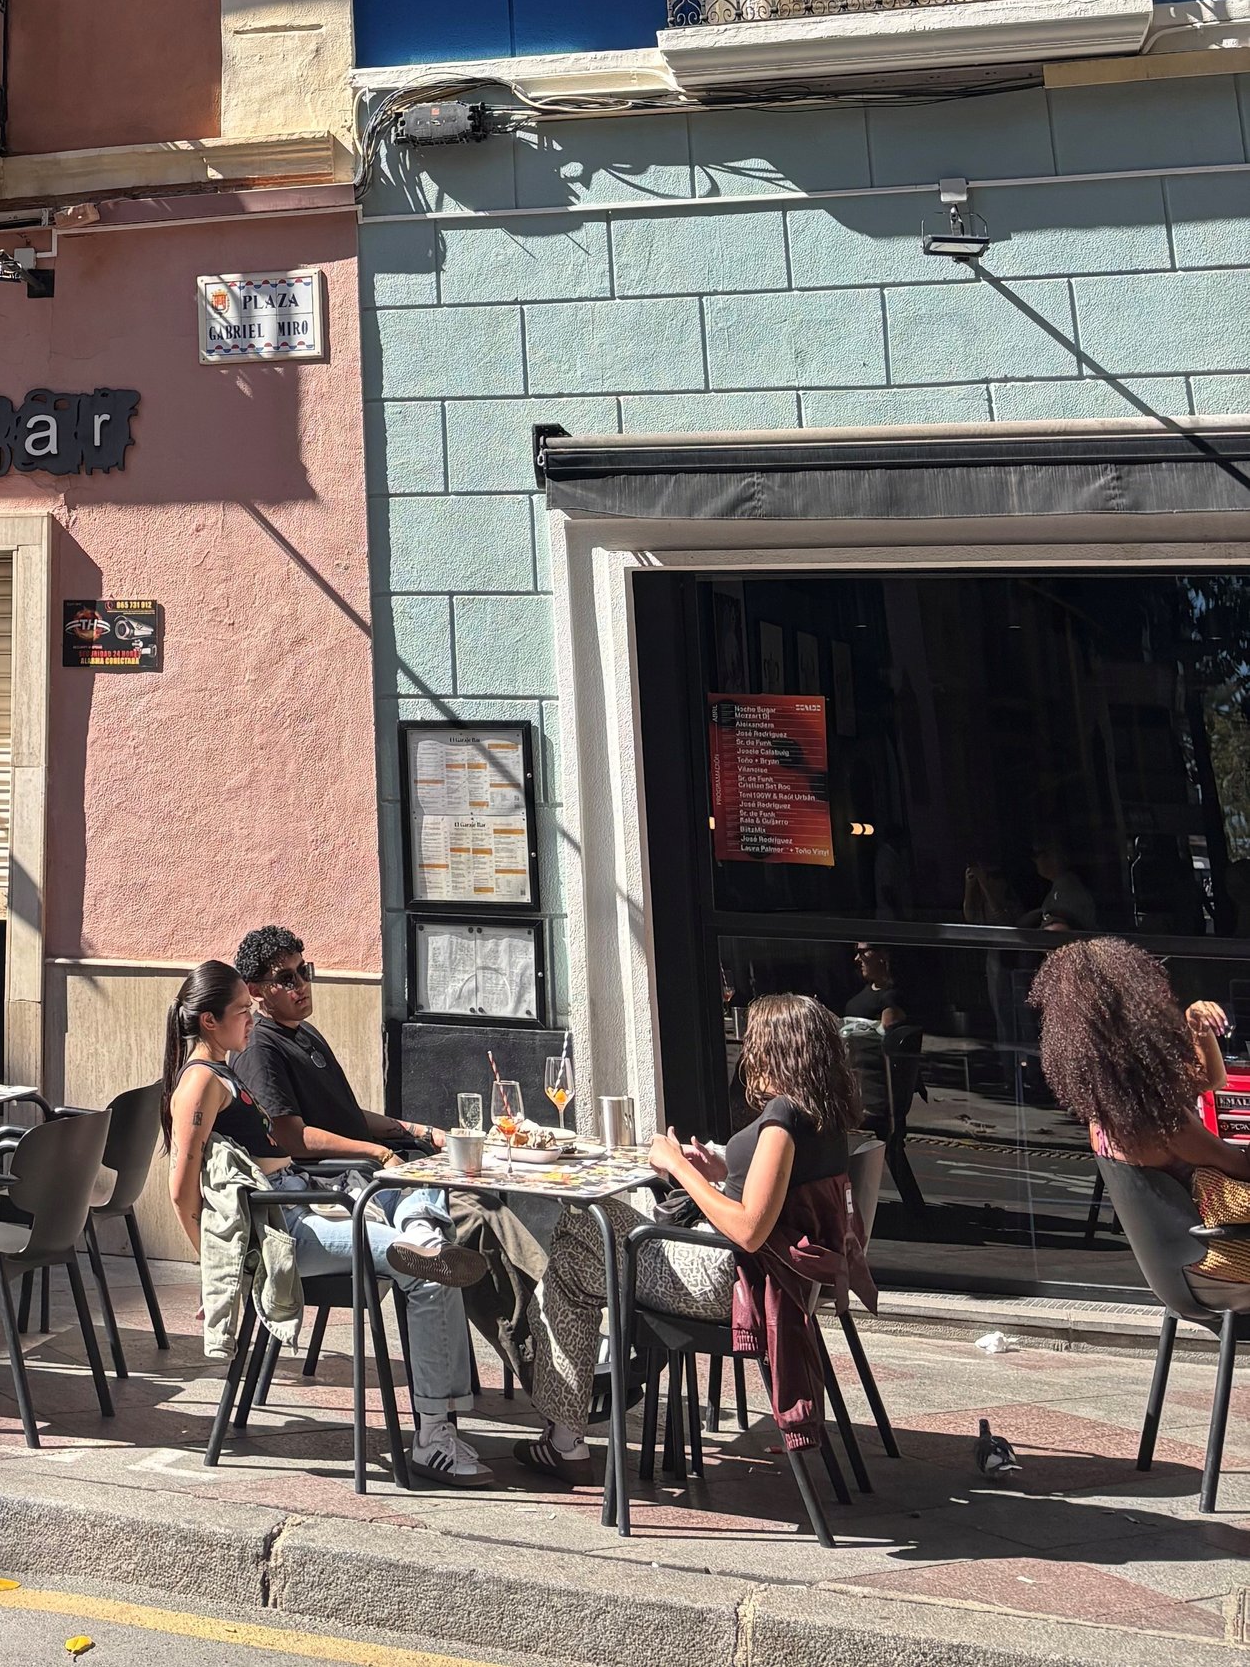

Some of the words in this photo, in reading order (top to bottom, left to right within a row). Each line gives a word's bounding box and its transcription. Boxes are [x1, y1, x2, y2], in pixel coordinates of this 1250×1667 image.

[243, 293, 300, 310] PLAZA
[209, 323, 265, 341] GABRIEL
[278, 320, 309, 337] MIRO
[113, 650, 122, 658] 24
[80, 657, 104, 665] ALARMA
